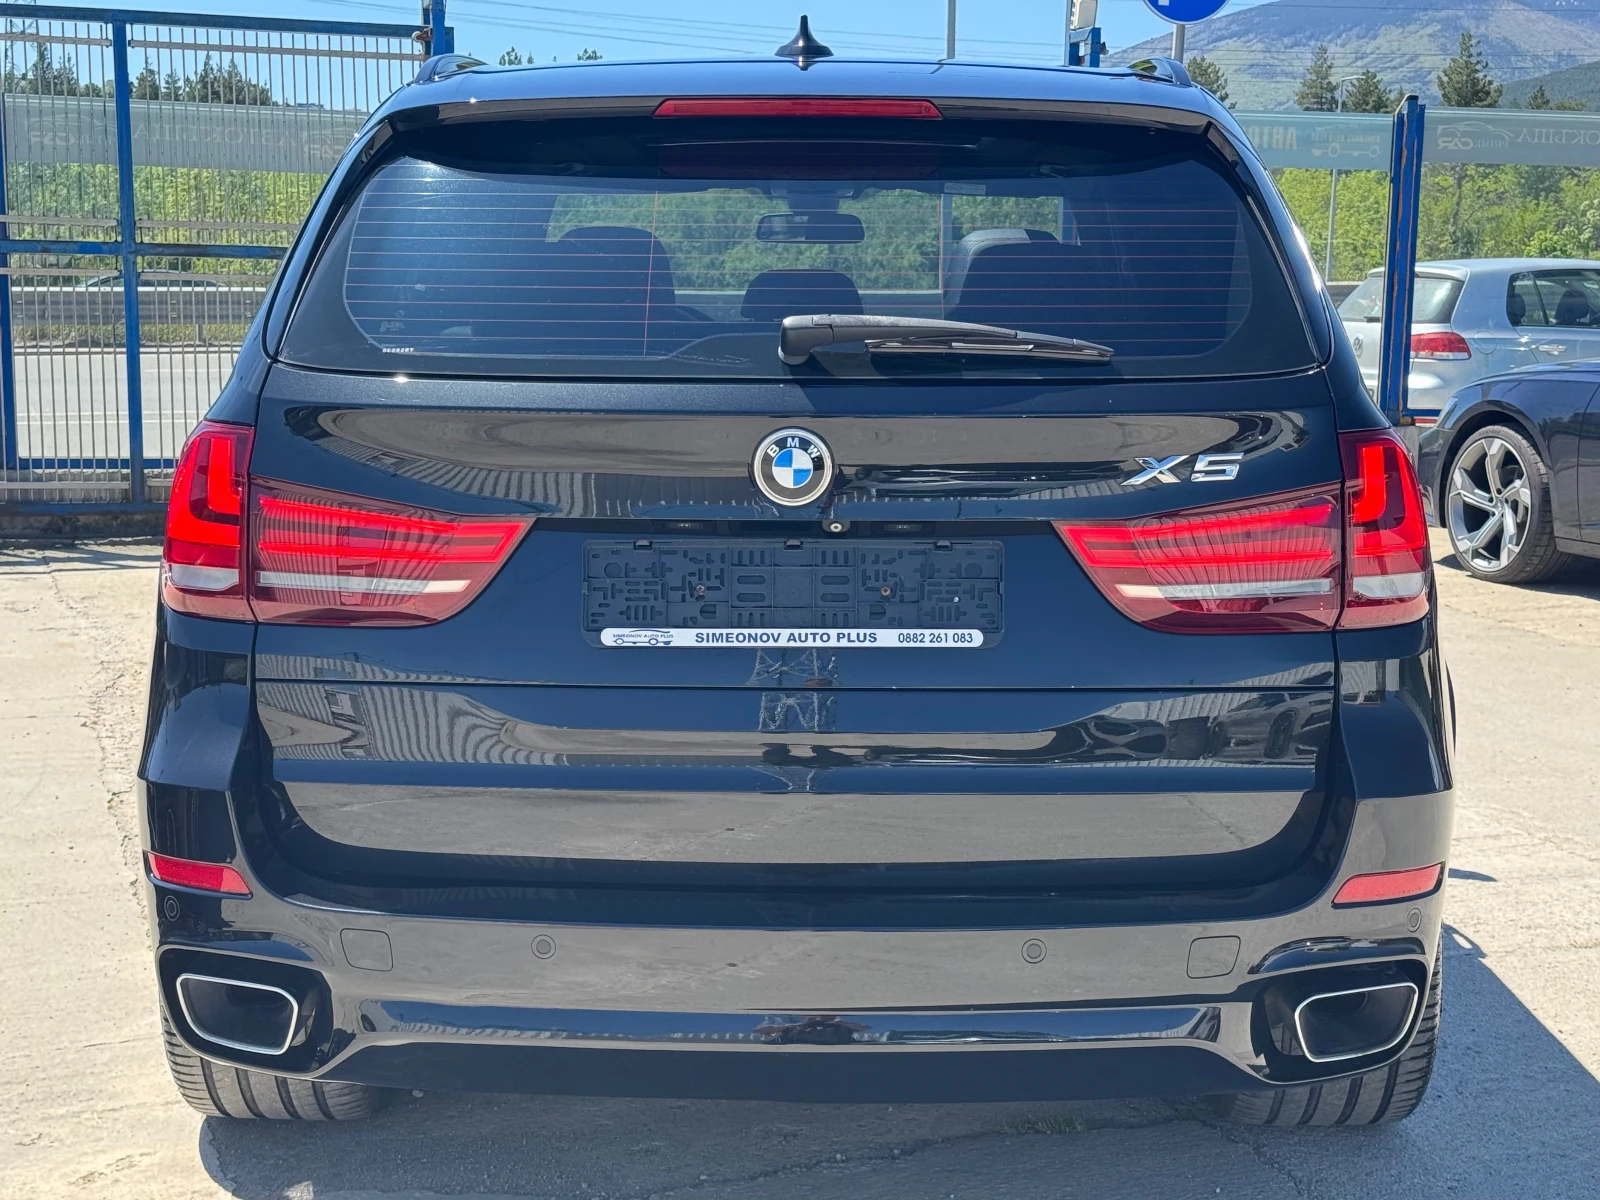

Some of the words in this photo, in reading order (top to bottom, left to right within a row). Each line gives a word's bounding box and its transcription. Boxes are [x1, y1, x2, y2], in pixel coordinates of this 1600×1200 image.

[767, 437, 820, 459] BMW
[1120, 452, 1244, 486] X5
[694, 632, 782, 644] SIMEONOV
[786, 632, 831, 644] AUTO
[836, 632, 878, 644] PLUS
[898, 632, 926, 644] 0882
[929, 632, 949, 644] 261
[952, 632, 974, 644] 083
